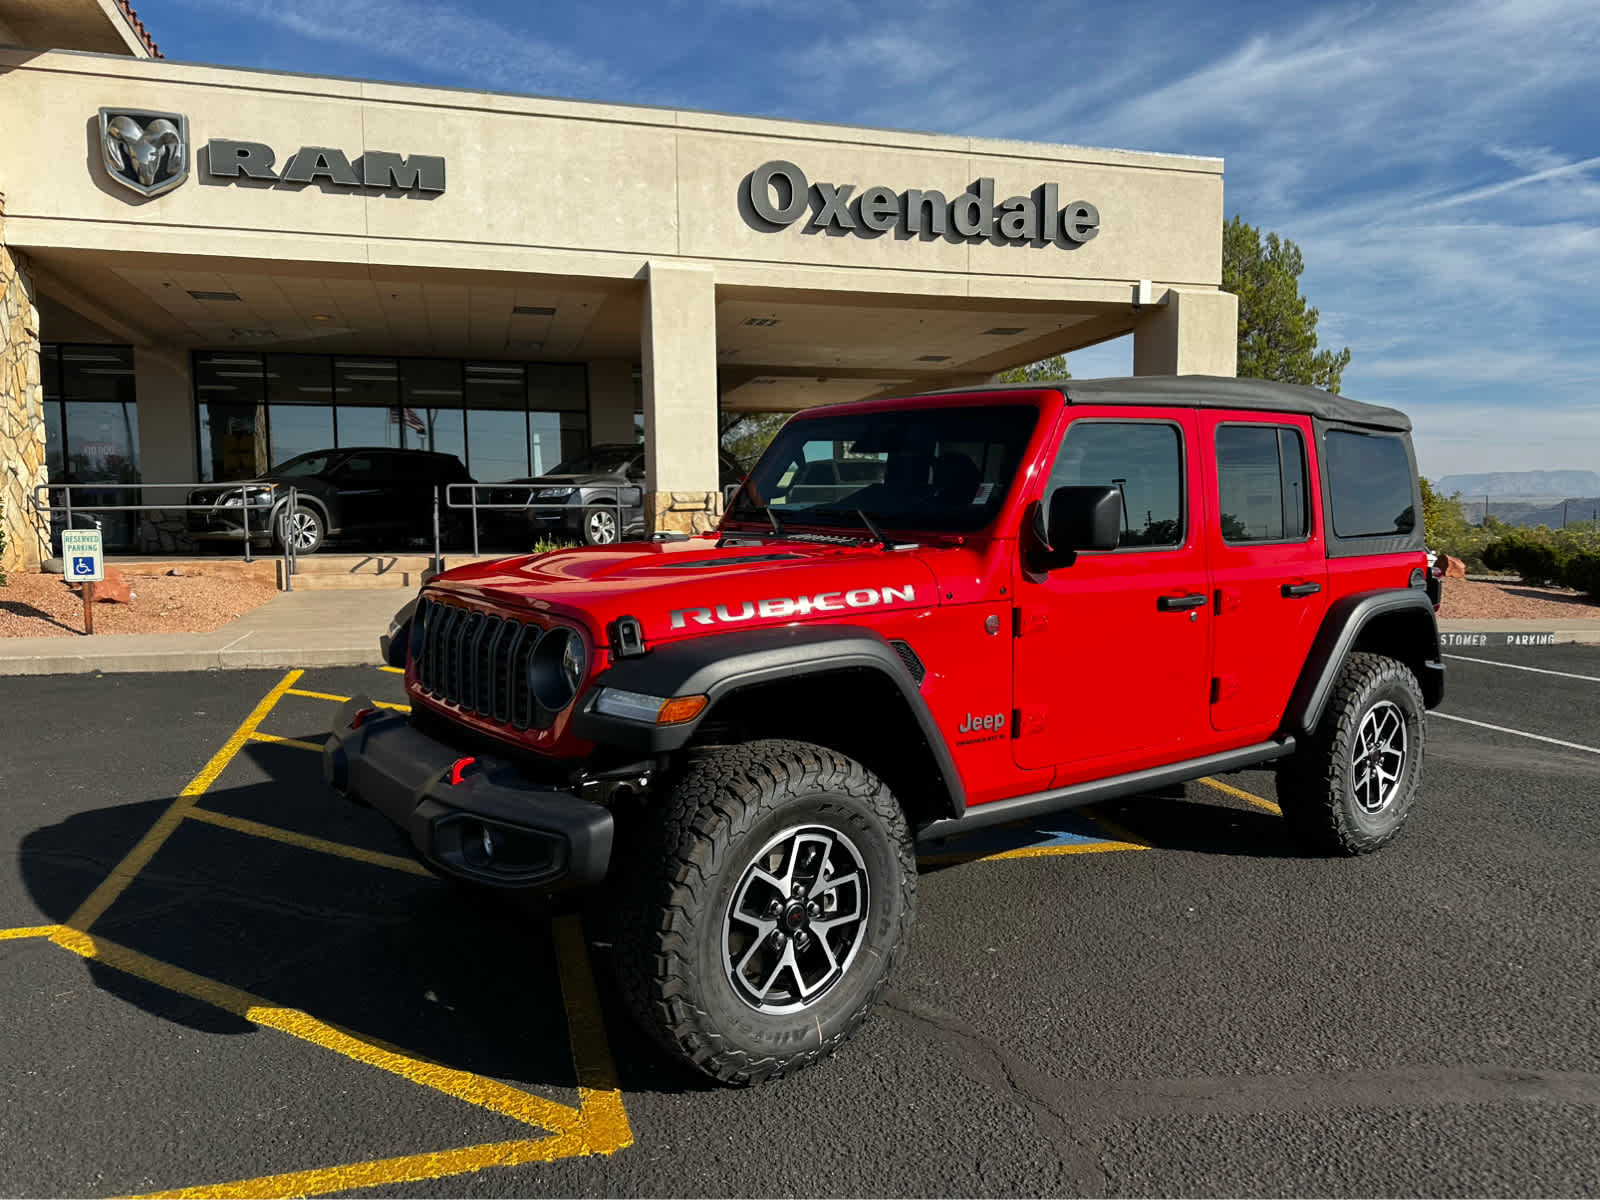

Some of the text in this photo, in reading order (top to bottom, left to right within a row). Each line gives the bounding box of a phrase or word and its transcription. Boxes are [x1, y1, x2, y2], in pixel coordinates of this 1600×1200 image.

[207, 138, 446, 194] RAM
[748, 159, 1100, 243] Oxendale
[63, 535, 99, 543] RESERVED
[67, 544, 98, 552] PARKING
[669, 584, 915, 630] RUBICON
[1440, 633, 1556, 646] STOMER PARKING
[958, 712, 1005, 733] Jeep
